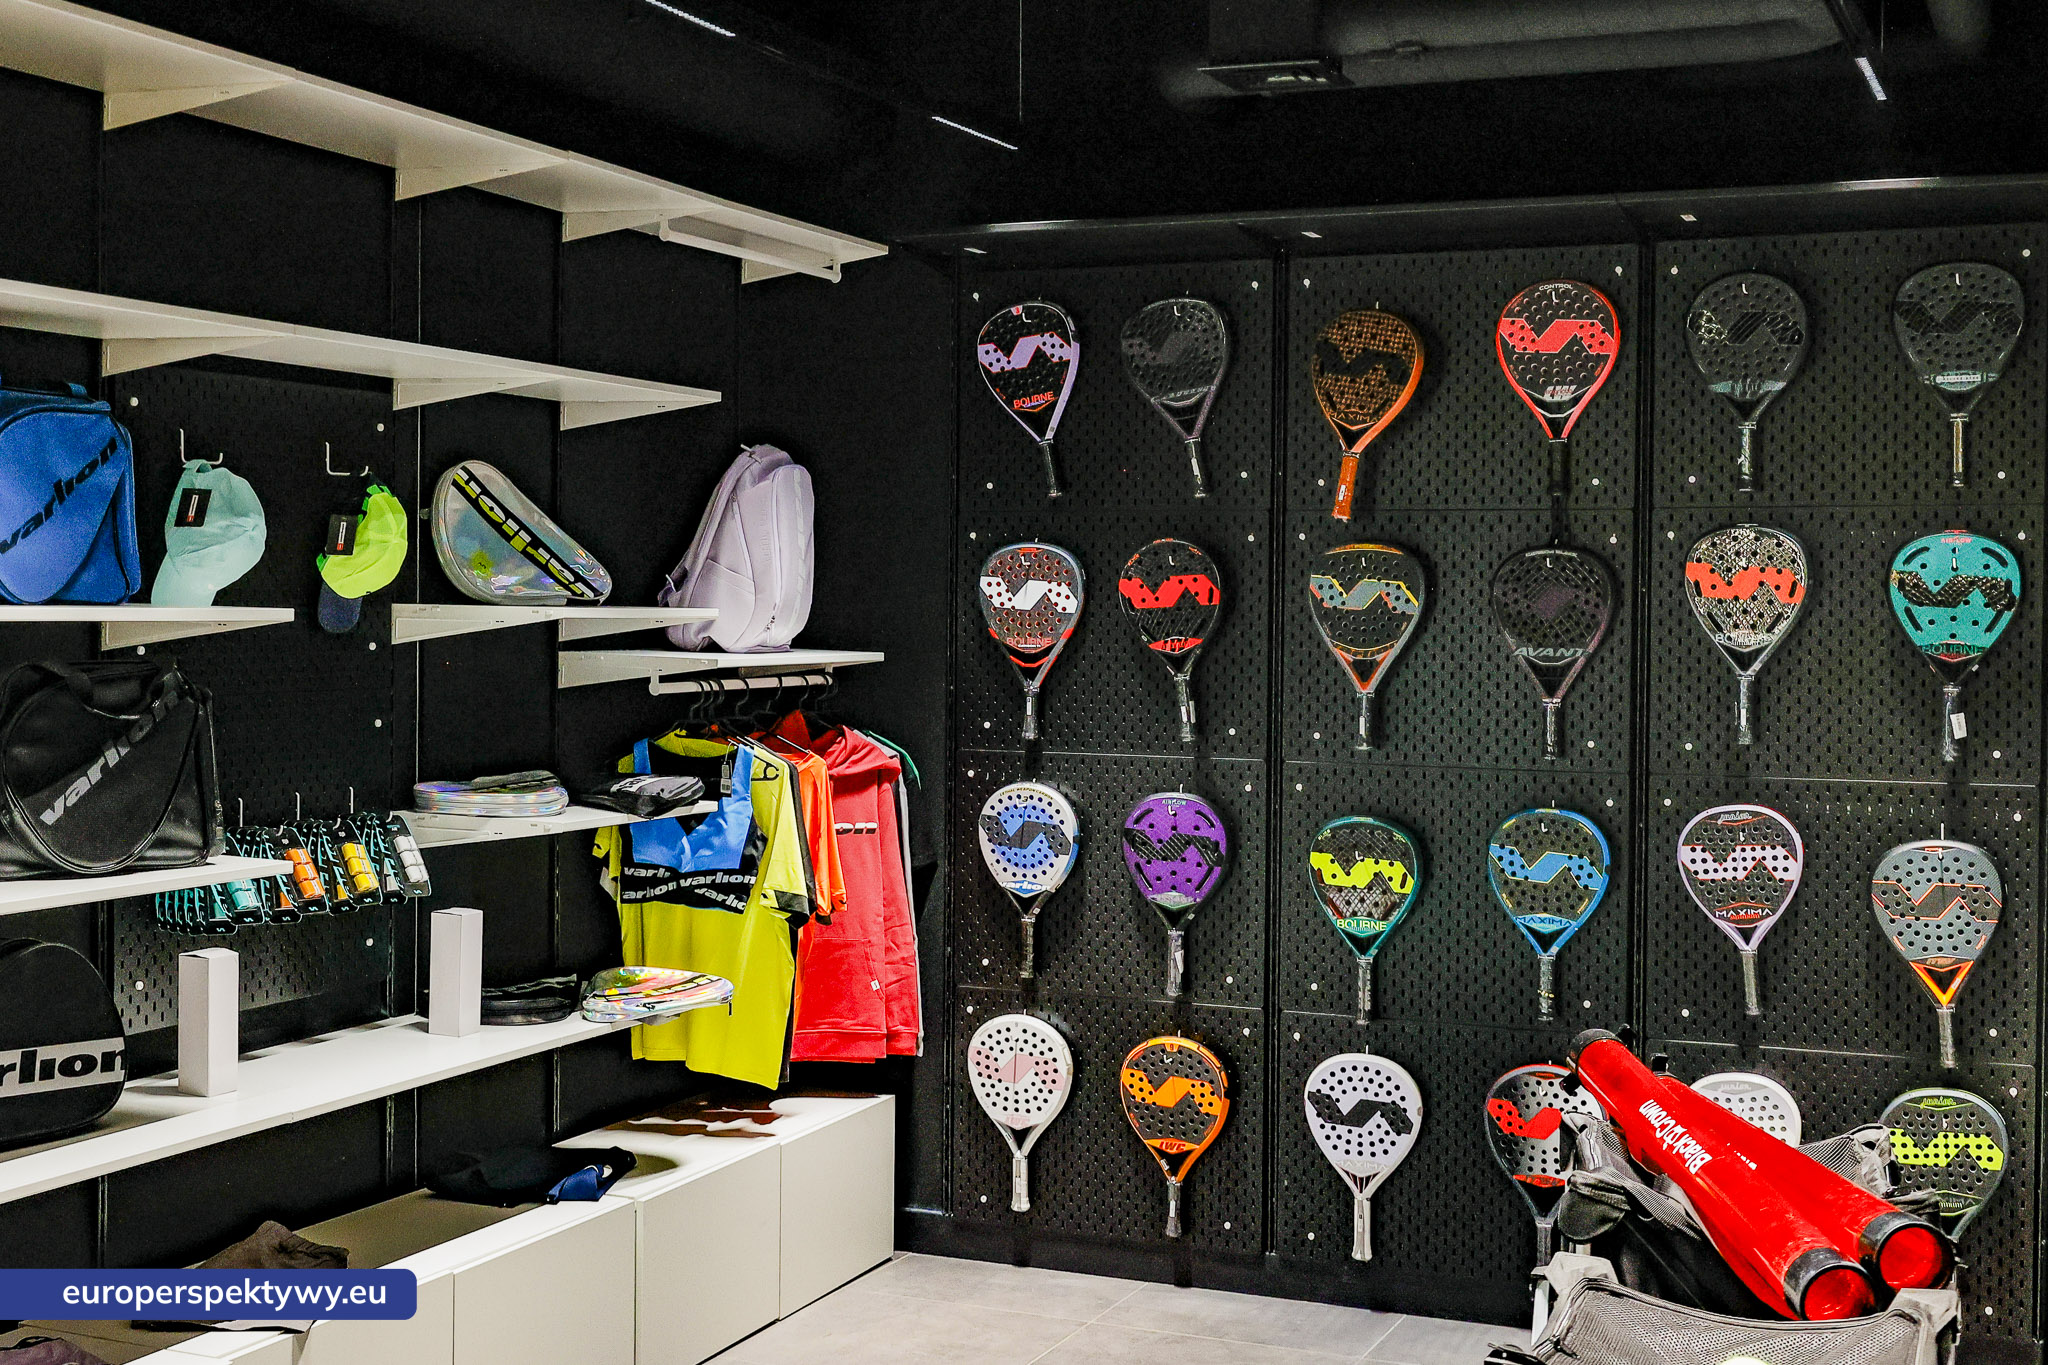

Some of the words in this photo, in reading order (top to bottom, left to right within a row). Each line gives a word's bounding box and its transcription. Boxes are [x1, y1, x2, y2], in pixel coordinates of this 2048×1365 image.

[1538, 283, 1573, 291] CONTROL
[1013, 391, 1055, 409] BOURNE
[1329, 411, 1380, 424] MAXIMA
[1512, 647, 1589, 658] AVANT
[622, 881, 677, 899] arlion
[1715, 908, 1772, 919] MAXIMA
[1336, 918, 1387, 931] BOURNE
[1515, 916, 1572, 927] MAXIMA
